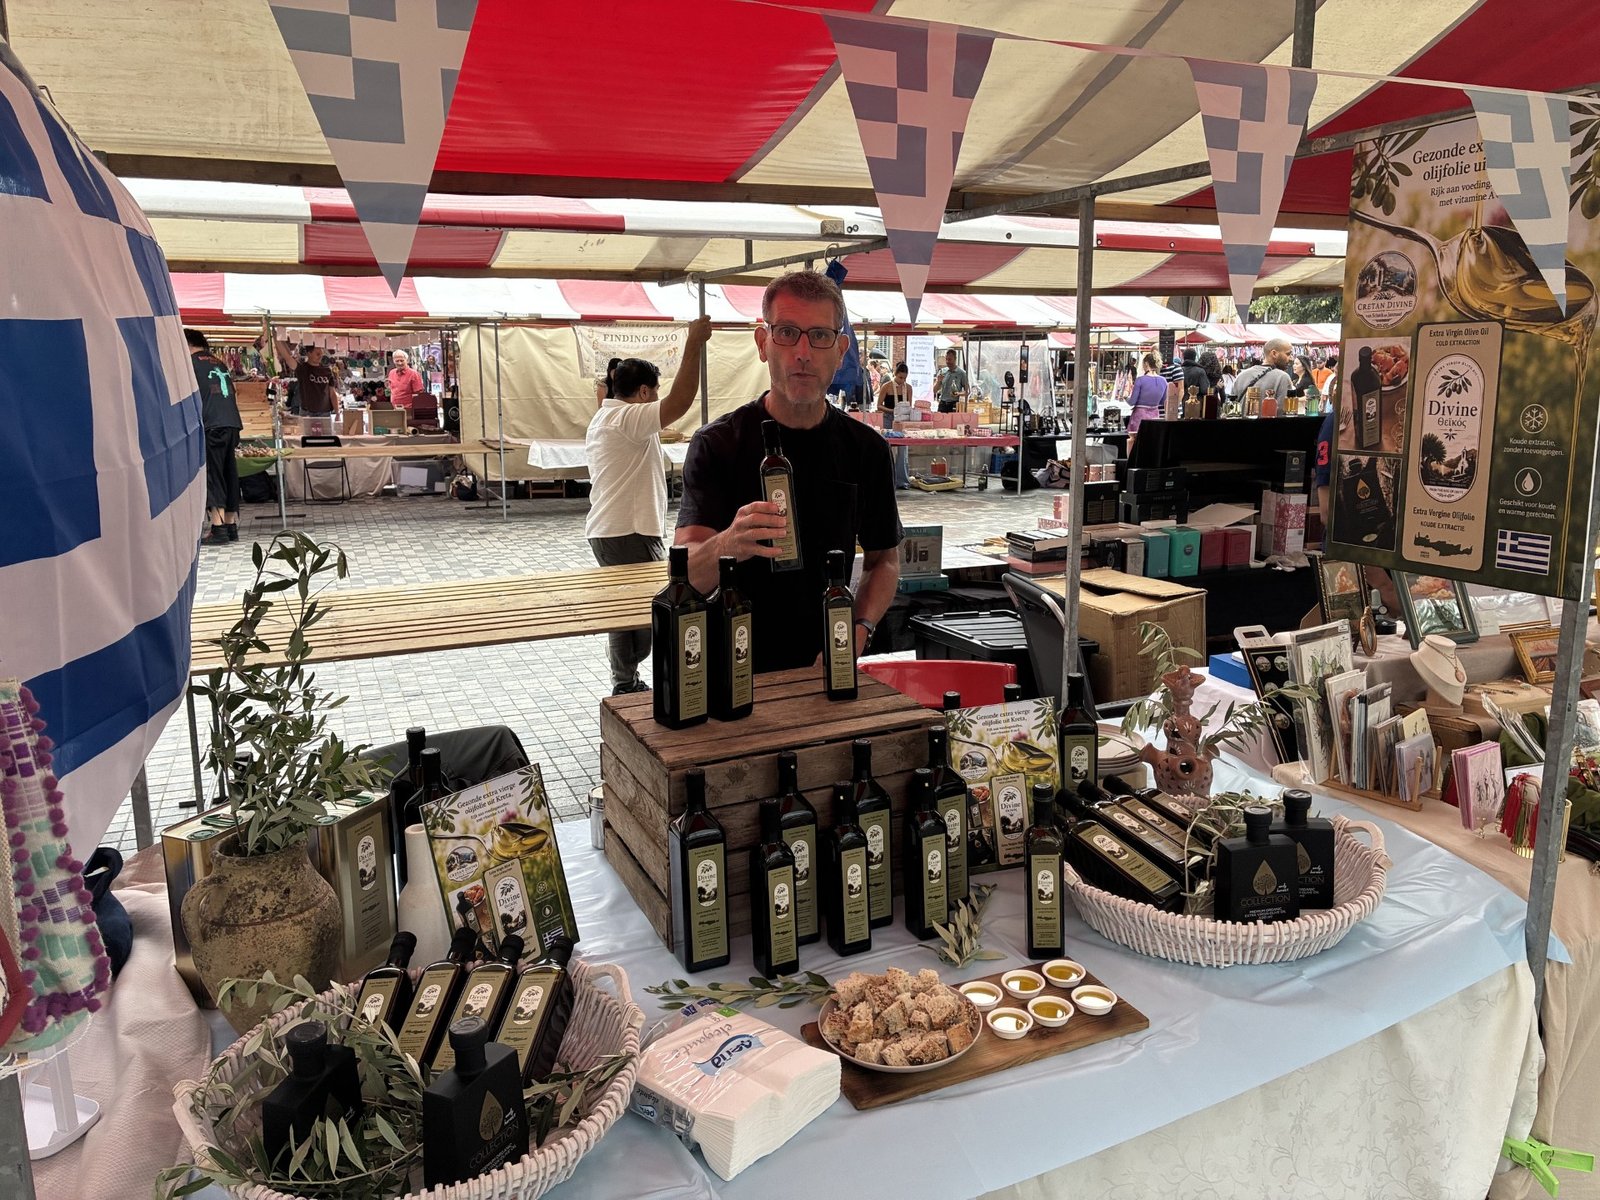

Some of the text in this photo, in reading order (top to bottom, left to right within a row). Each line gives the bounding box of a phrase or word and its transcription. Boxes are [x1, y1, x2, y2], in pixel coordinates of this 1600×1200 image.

[1413, 142, 1483, 164] Gezonde ex
[1423, 157, 1486, 182] olijfolie ui
[1431, 180, 1492, 197] Rijk aan voeding
[1455, 193, 1487, 204] vitamine
[1488, 191, 1494, 199] A
[1357, 300, 1413, 310] CRETAN DIVINE
[603, 334, 678, 342] FINDING YOYO
[1446, 329, 1463, 338] Virgin
[1428, 400, 1478, 417] Divine
[1317, 440, 1328, 465] 3
[1523, 447, 1564, 456] toevoegingen.
[1500, 498, 1523, 506] Geschikt
[1538, 502, 1556, 510] koude
[1413, 507, 1475, 521] Extra Vergine Olijfolie
[1438, 523, 1465, 531] EXTRACTIE
[457, 783, 516, 809] Gezonde extra vierge
[498, 892, 520, 906] Divine
[1240, 895, 1290, 906] COLLECTION
[671, 1023, 733, 1059] elegante
